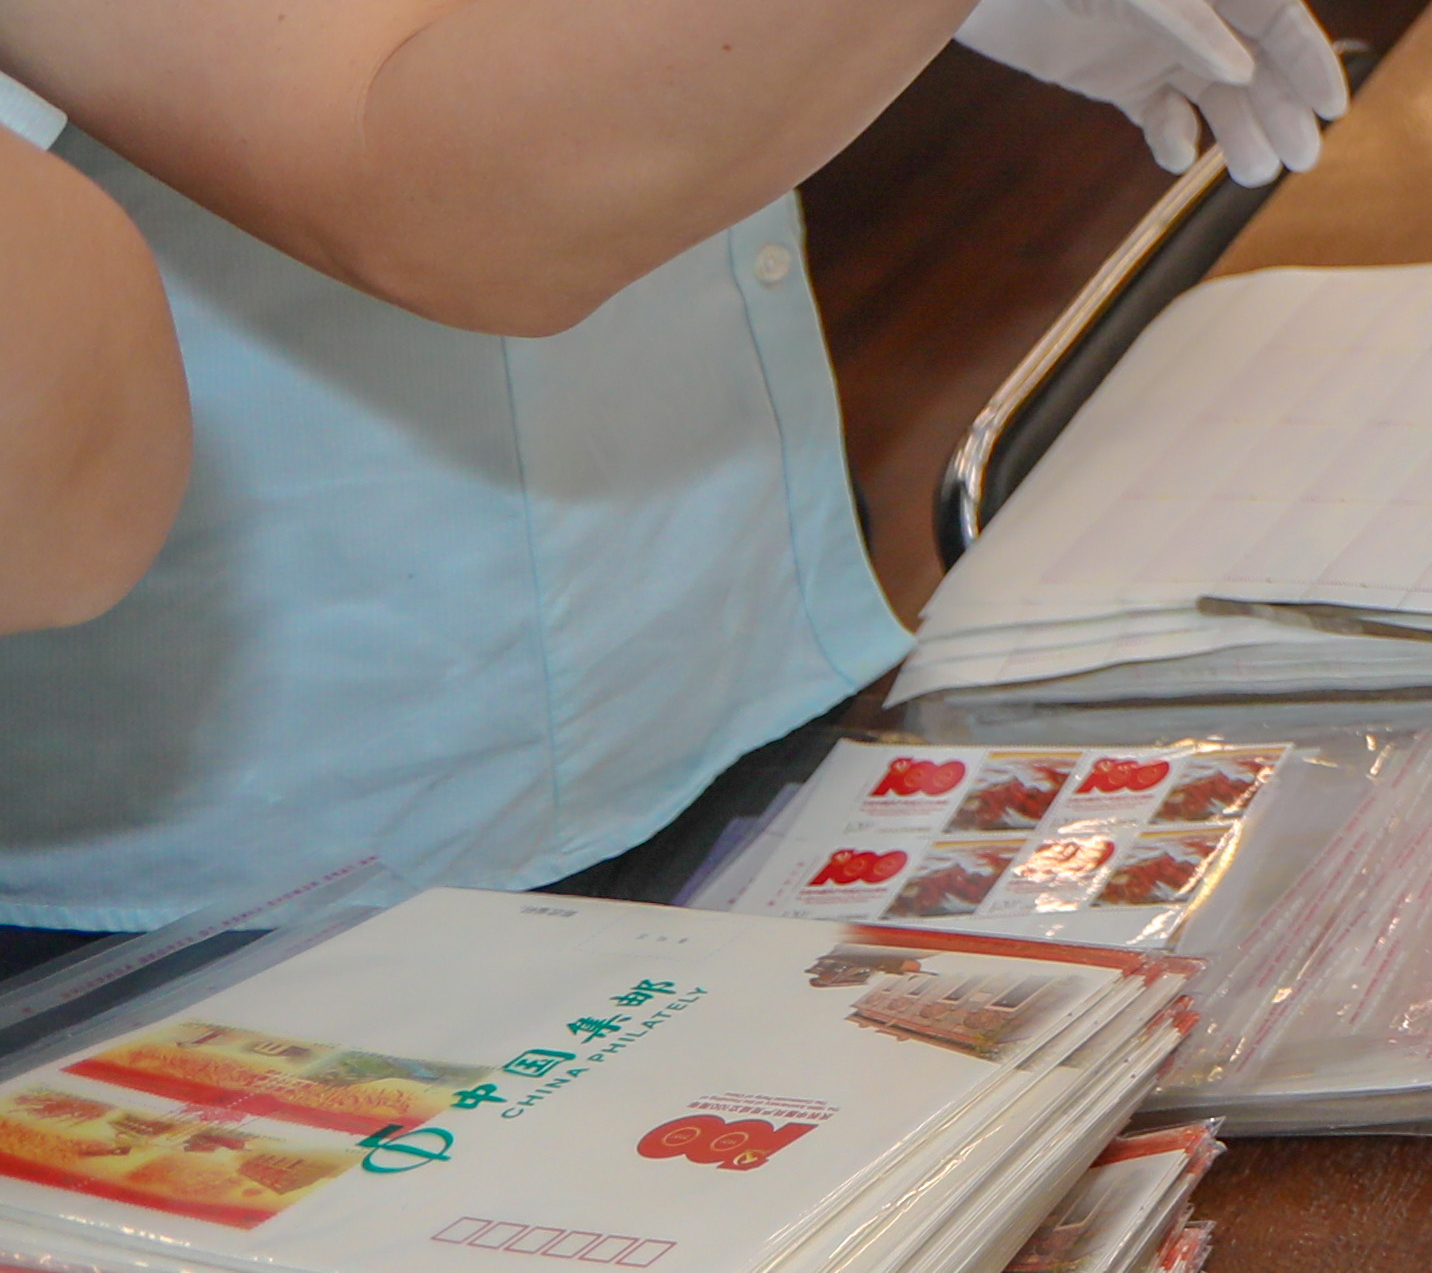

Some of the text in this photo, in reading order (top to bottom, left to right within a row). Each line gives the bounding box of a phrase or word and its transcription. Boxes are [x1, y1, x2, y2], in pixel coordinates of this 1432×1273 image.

[450, 978, 677, 1110] 中国集邮
[500, 986, 708, 1119] CHINA PHILATELY
